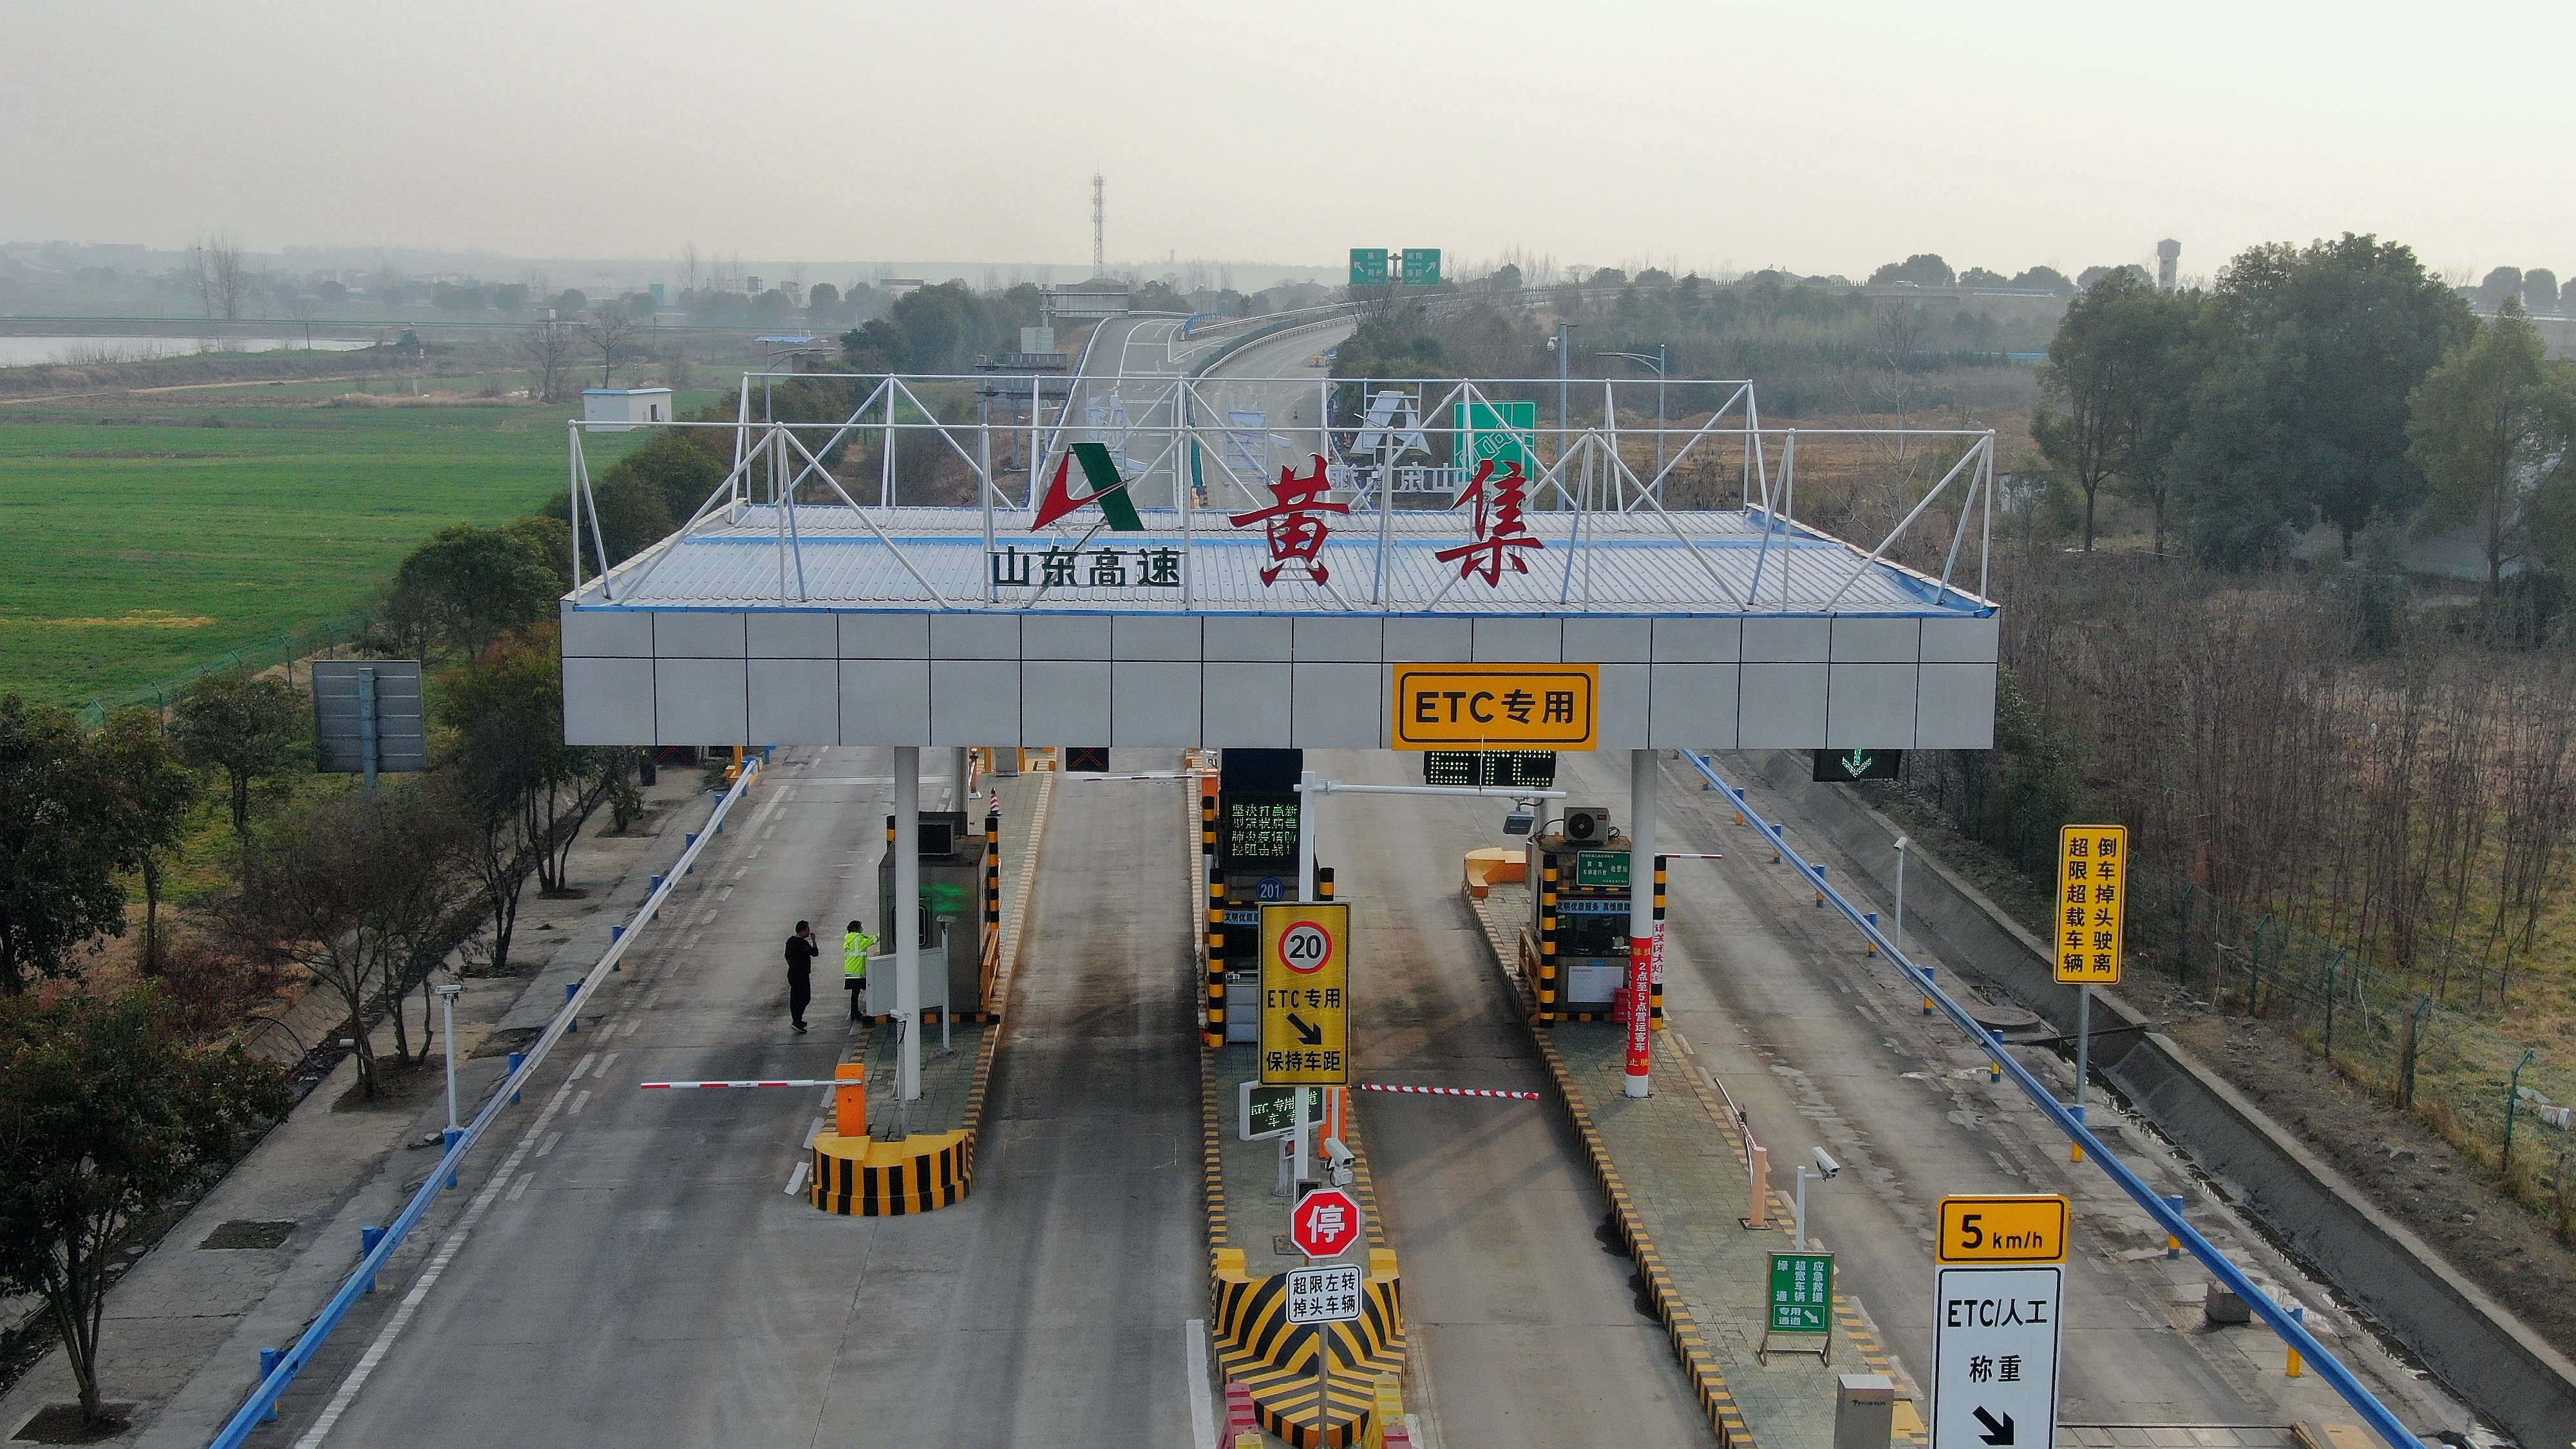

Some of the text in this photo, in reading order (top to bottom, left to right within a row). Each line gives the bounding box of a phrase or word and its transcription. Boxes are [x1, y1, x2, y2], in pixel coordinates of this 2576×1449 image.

[1228, 453, 1544, 589] 黄集
[992, 544, 1180, 587] 山东高速
[1416, 688, 1573, 724] ETC专用
[1430, 749, 1551, 785] ETC
[1260, 882, 1281, 898] 201
[1556, 902, 1599, 911] 文明优质服务
[2063, 837, 2089, 974] 超限超载车辆
[2092, 837, 2117, 974] 倒车掉头驶离
[1289, 934, 1322, 959] 20
[1651, 923, 1665, 974] 请关闭大灯
[1267, 988, 1340, 1009] ETC专用
[1634, 961, 1648, 1053] 2点至5点营运客车
[1266, 1050, 1341, 1072] 保持车距
[1306, 1204, 1345, 1244] 停
[1960, 1214, 2043, 1249] 5 km/h
[1293, 1272, 1356, 1295] 超限左转
[1776, 1260, 1788, 1302] 绿通
[1812, 1260, 1824, 1303] 应急救援
[1293, 1294, 1356, 1318] 掉头车辆
[1778, 1316, 1801, 1325] 通道
[1779, 1307, 1801, 1316] 专用
[1947, 1298, 2048, 1328] ETC/人工
[1969, 1354, 2022, 1383] 称重
